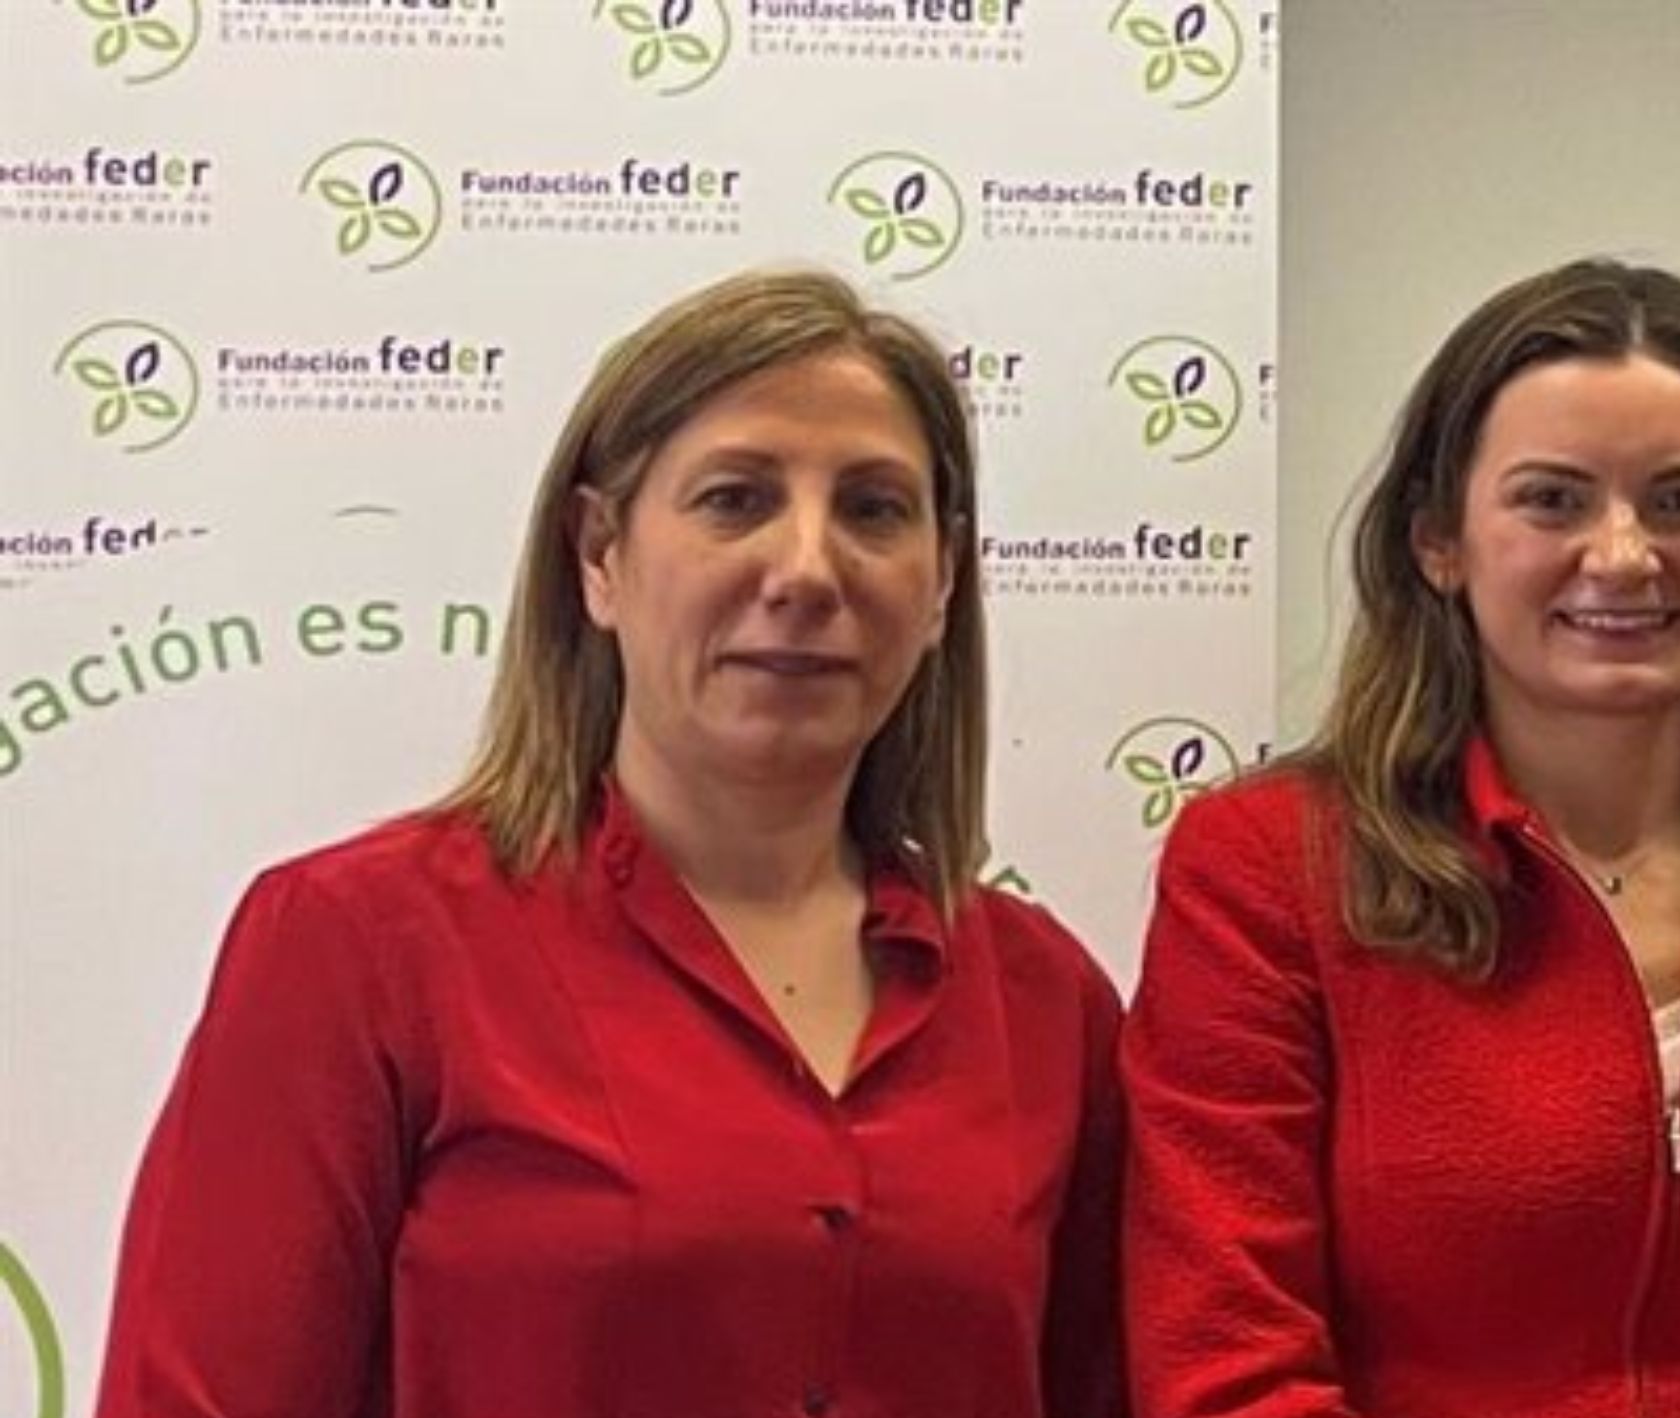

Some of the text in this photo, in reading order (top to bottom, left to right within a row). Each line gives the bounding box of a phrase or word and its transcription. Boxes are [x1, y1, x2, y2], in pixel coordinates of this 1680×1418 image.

[85, 147, 211, 186] feder
[461, 159, 740, 197] Fundación feder
[982, 168, 1252, 207] Fundación feder
[218, 335, 503, 374] Fundación feder
[950, 345, 1021, 379] der
[981, 523, 1250, 560] Fundación feder
[299, 597, 403, 657] es
